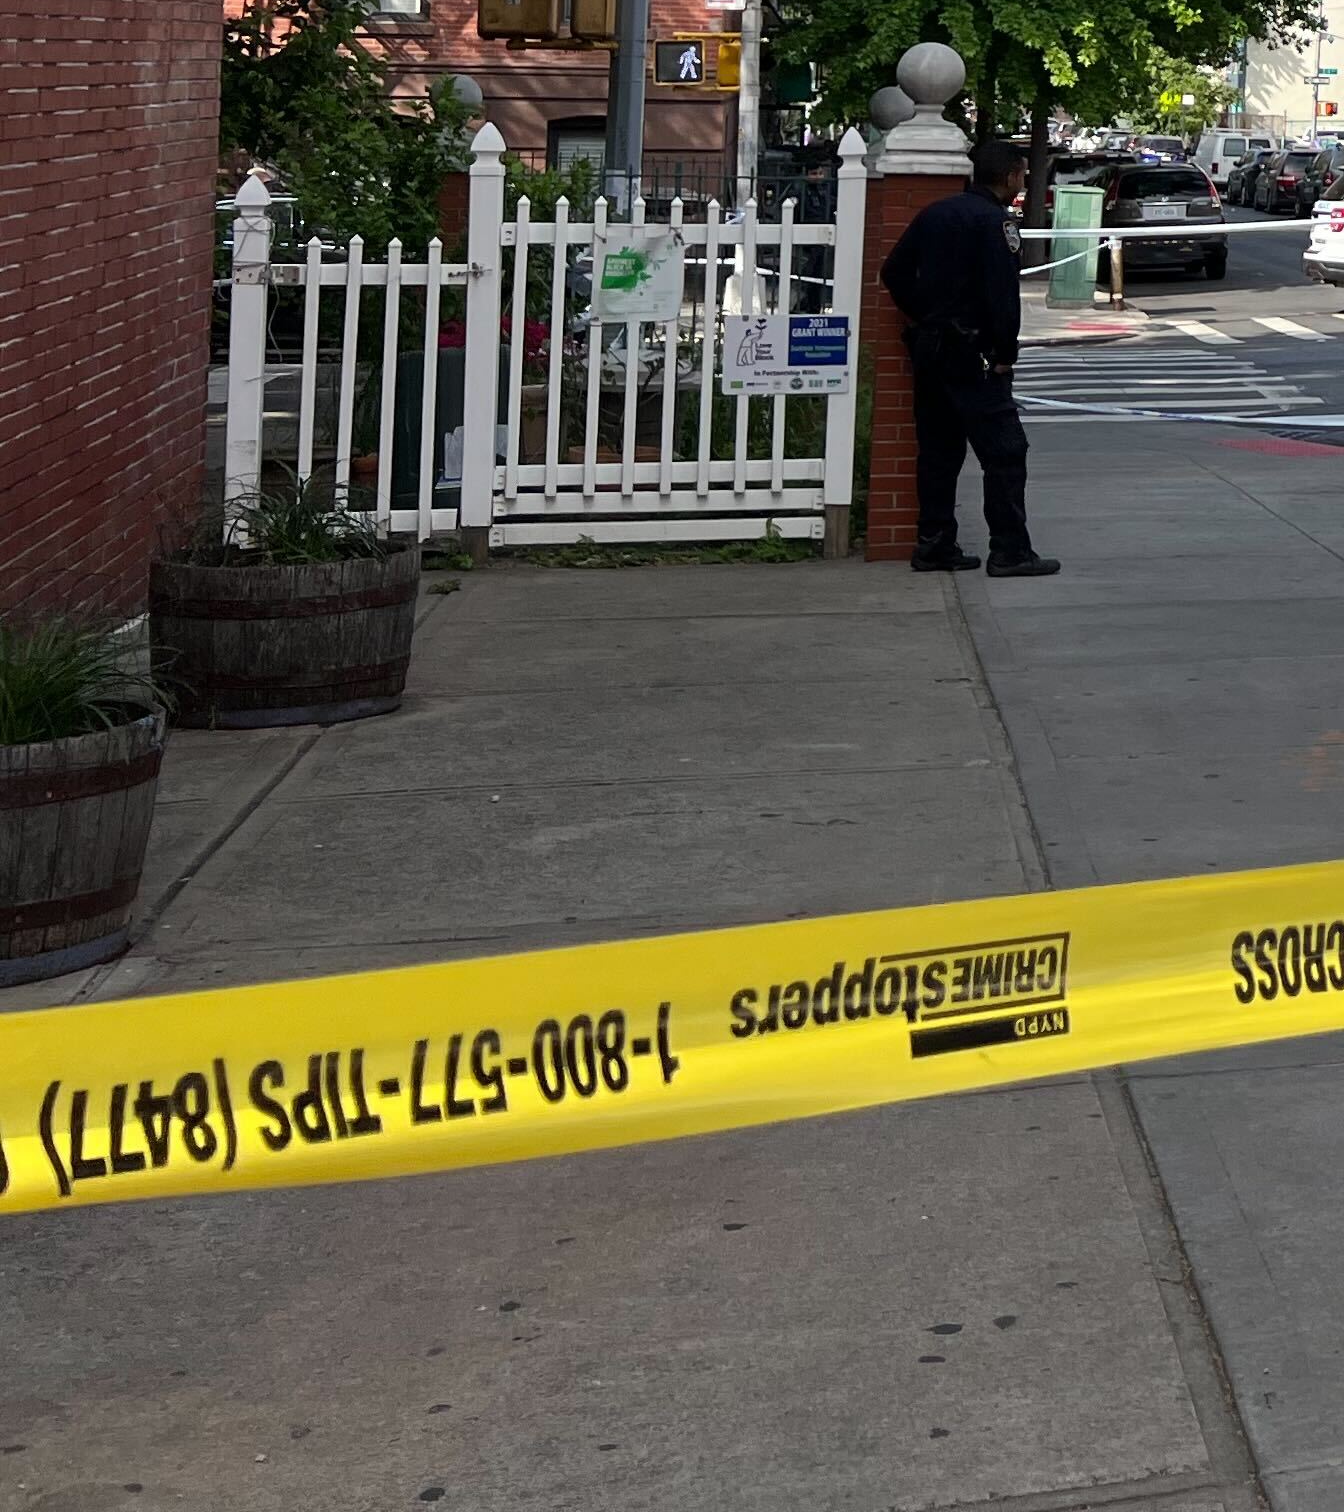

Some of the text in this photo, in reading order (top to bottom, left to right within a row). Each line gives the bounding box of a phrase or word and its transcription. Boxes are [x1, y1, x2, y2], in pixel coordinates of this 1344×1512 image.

[791, 327, 846, 338] GRANT WINNER
[808, 318, 829, 328] 2021
[1014, 1011, 1065, 1037] NYPD
[248, 1001, 680, 1152] 1-800-577-TIPS
[39, 1057, 238, 1196] (8477)
